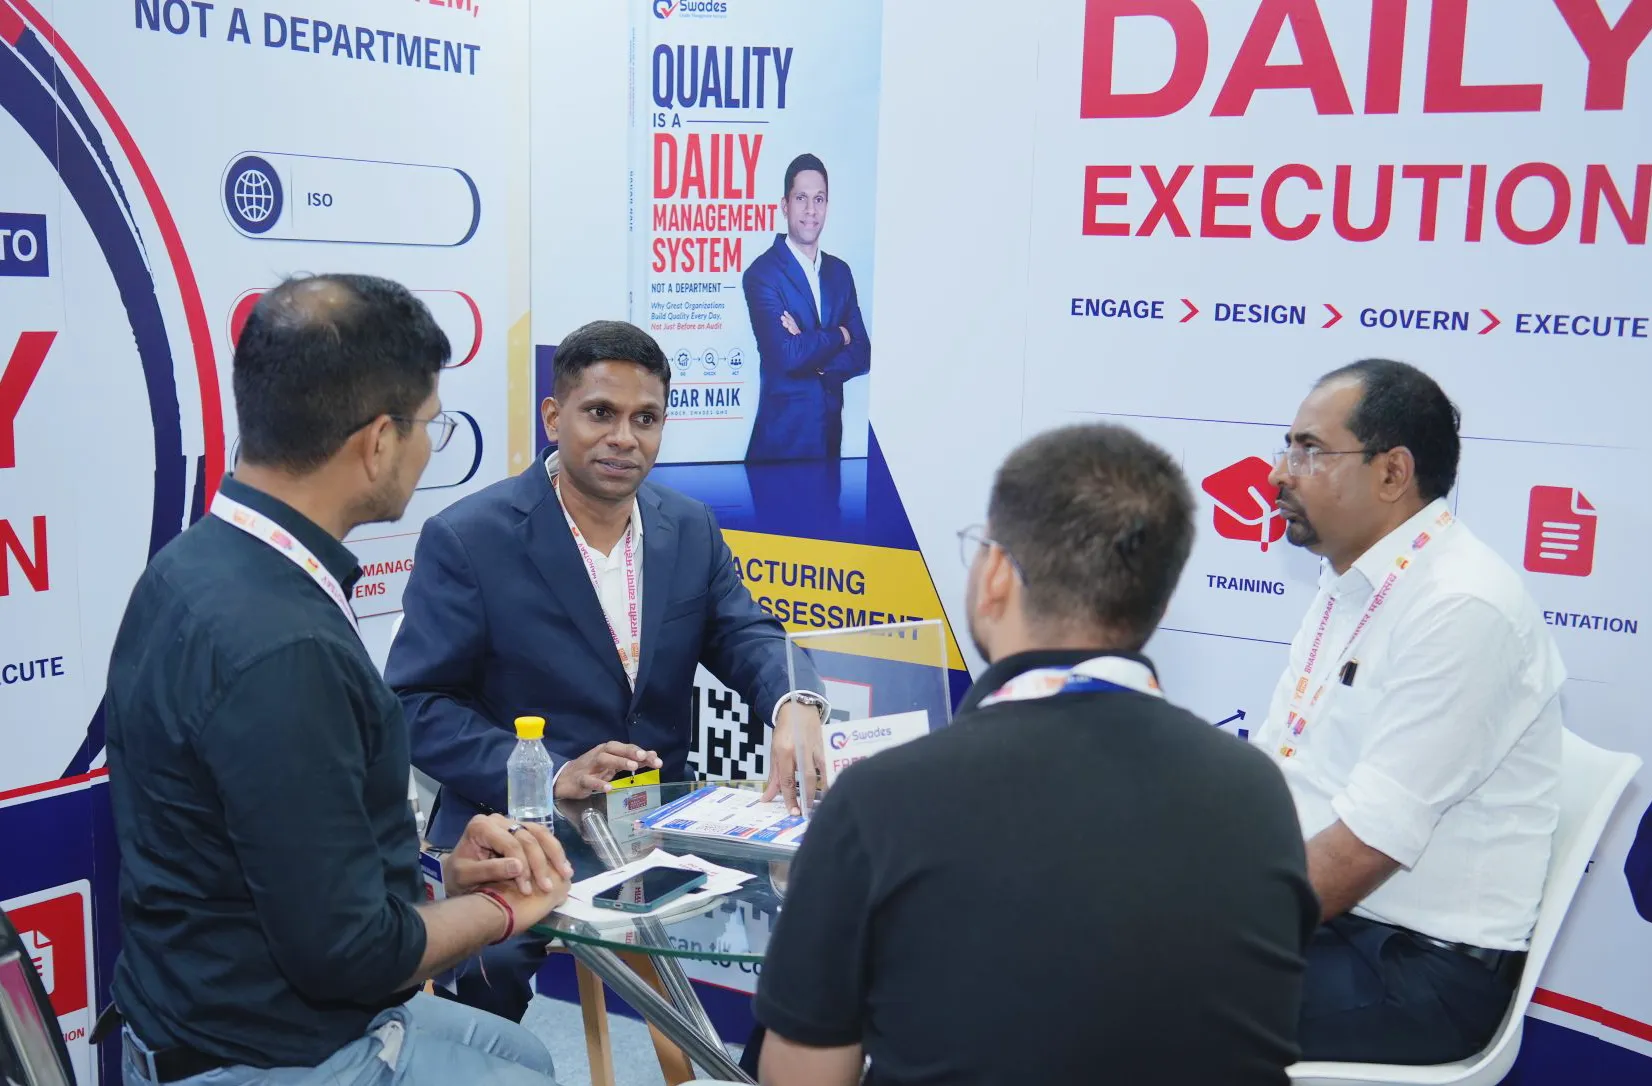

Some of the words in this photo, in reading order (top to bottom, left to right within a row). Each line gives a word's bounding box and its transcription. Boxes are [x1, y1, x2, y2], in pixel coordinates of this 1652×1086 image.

[680, 0, 727, 13] Swades
[134, 0, 214, 38] NOT
[227, 8, 251, 44] A
[264, 12, 481, 75] DEPARTMENT
[1080, 0, 1652, 119] DAILY
[653, 44, 794, 110] QUALITY
[653, 113, 666, 128] IS
[671, 113, 681, 128] A
[653, 133, 763, 200] DAILY
[307, 192, 333, 208] ISO
[1082, 162, 1652, 245] EXECUTION
[653, 204, 778, 233] MANAGEMENT
[651, 237, 743, 274] SYSTEM
[651, 283, 666, 293] NOT
[668, 283, 673, 293] A
[676, 283, 722, 293] DEPARTMENT
[651, 302, 664, 310] Why
[666, 302, 682, 310] Great
[684, 302, 725, 311] Organizations
[667, 313, 689, 321] Quality
[691, 312, 707, 320] Every
[677, 323, 696, 331] Before
[1070, 298, 1165, 320] ENGAGE
[1214, 303, 1307, 326] DESIGN
[1360, 307, 1470, 332] GOVERN
[1515, 313, 1651, 339] EXECUTE
[669, 388, 699, 408] GAR
[705, 387, 740, 407] NAIK
[362, 558, 414, 577] MANAG
[731, 556, 866, 596] ACTURING
[355, 583, 386, 598] EMS
[1206, 574, 1285, 596] TRAINING
[757, 596, 924, 640] SSESSMENT
[1543, 610, 1639, 634] ENTATION
[0, 656, 65, 685] CUTE
[851, 727, 892, 741] Swades
[63, 1027, 85, 1043] ION
